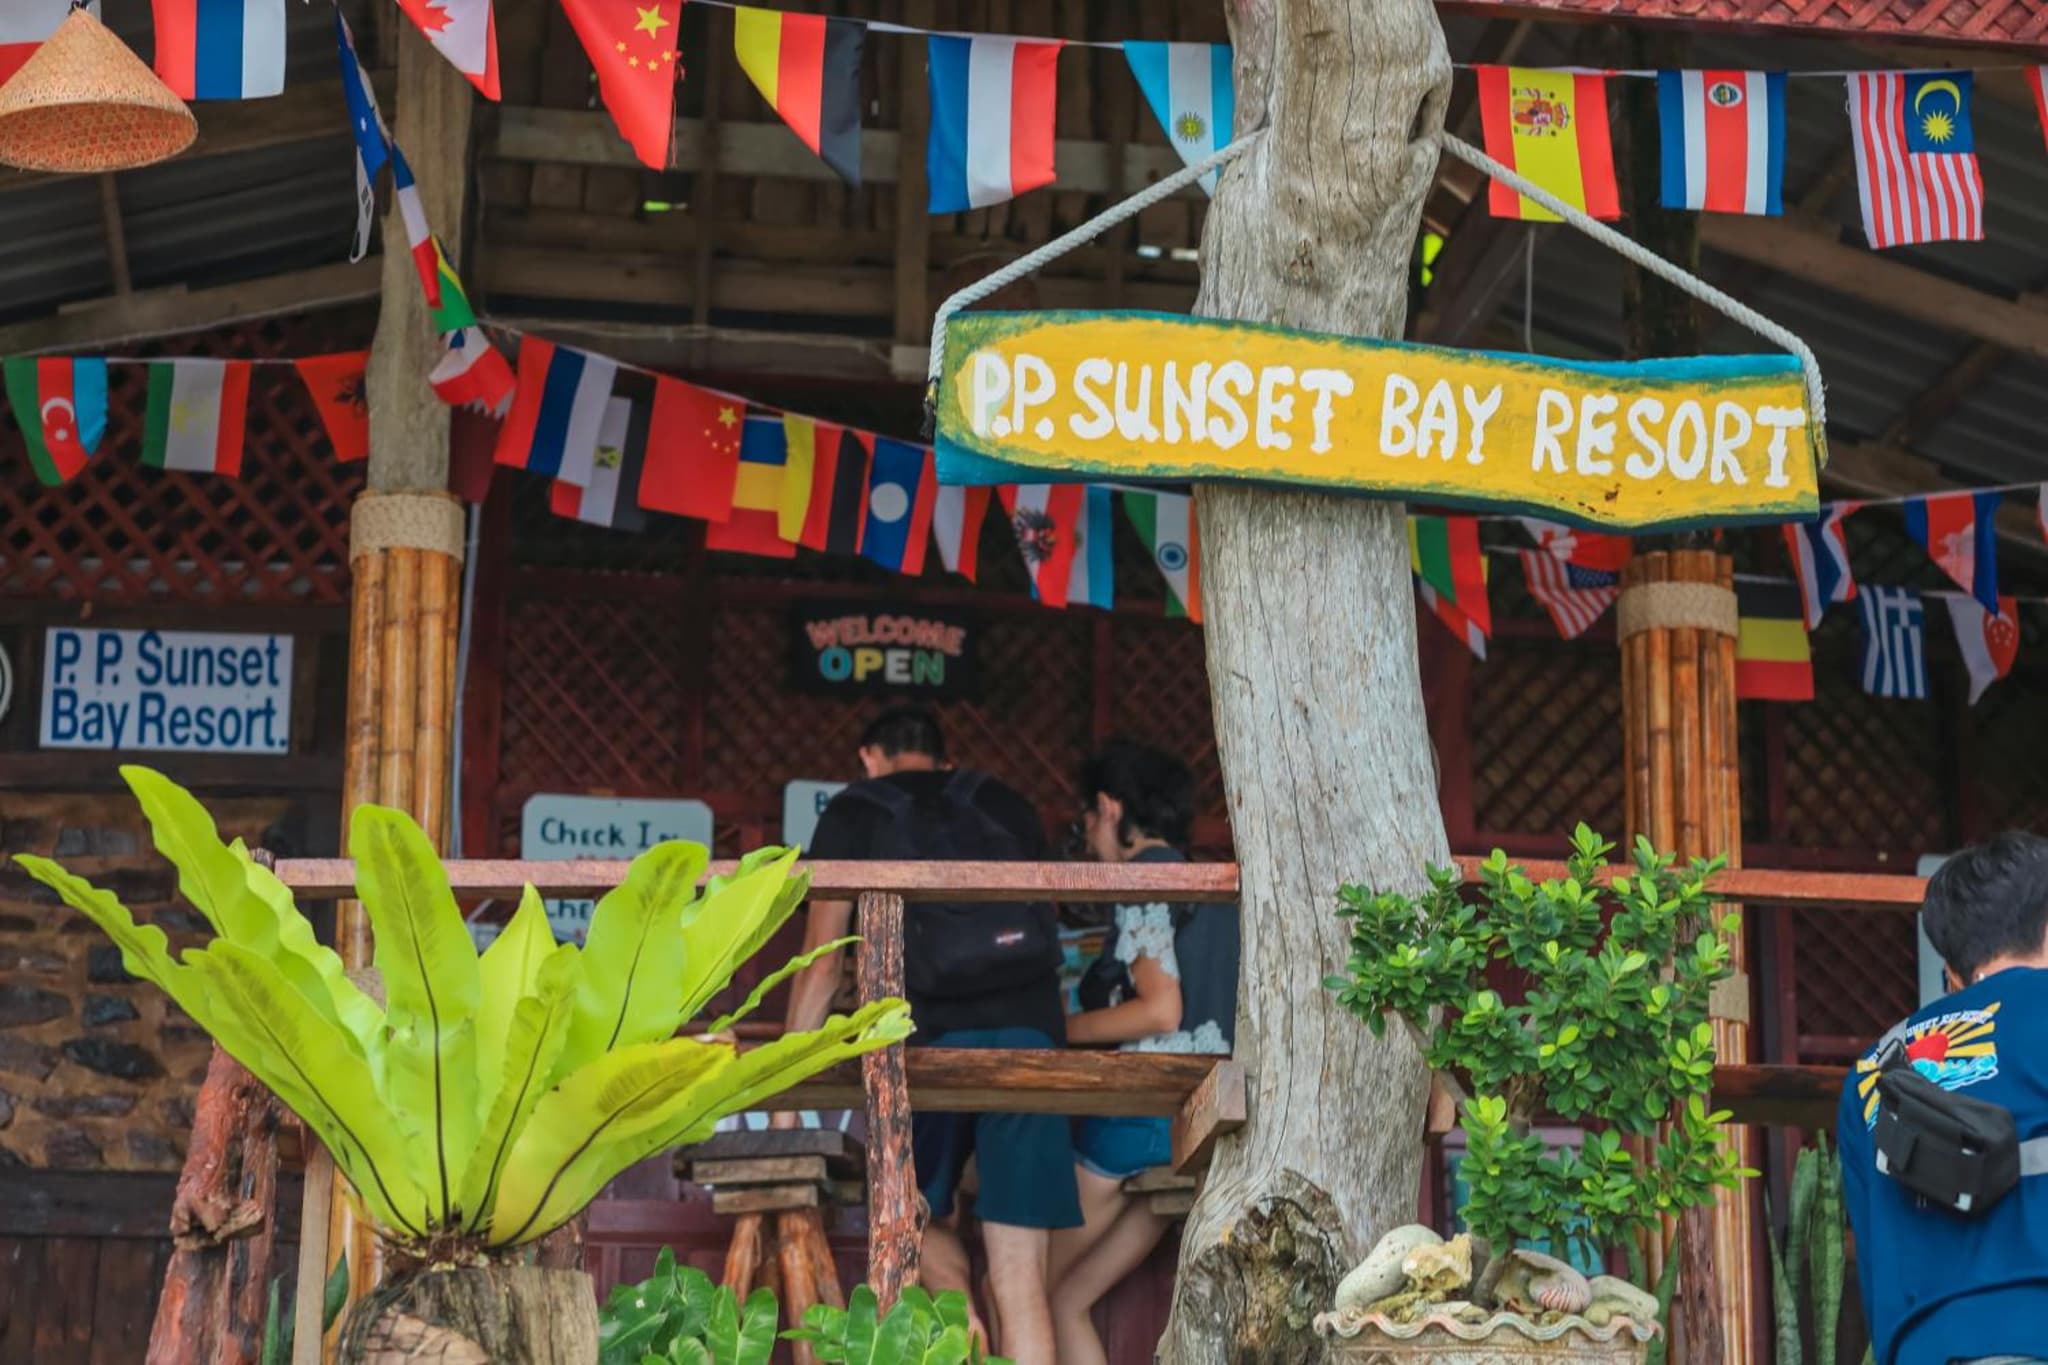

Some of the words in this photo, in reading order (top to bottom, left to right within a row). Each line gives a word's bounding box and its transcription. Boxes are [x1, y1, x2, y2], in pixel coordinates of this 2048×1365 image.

[972, 351, 1056, 440] P.P.
[1069, 357, 1354, 454] SUNSET
[1379, 373, 1502, 464] BAY
[1531, 389, 1806, 487] RESORT
[136, 630, 280, 687] Sunset
[805, 614, 967, 657] WELCOME
[819, 646, 946, 686] OPEN
[50, 688, 129, 750] Bay
[137, 691, 288, 748] Resort.
[540, 817, 625, 848] Check
